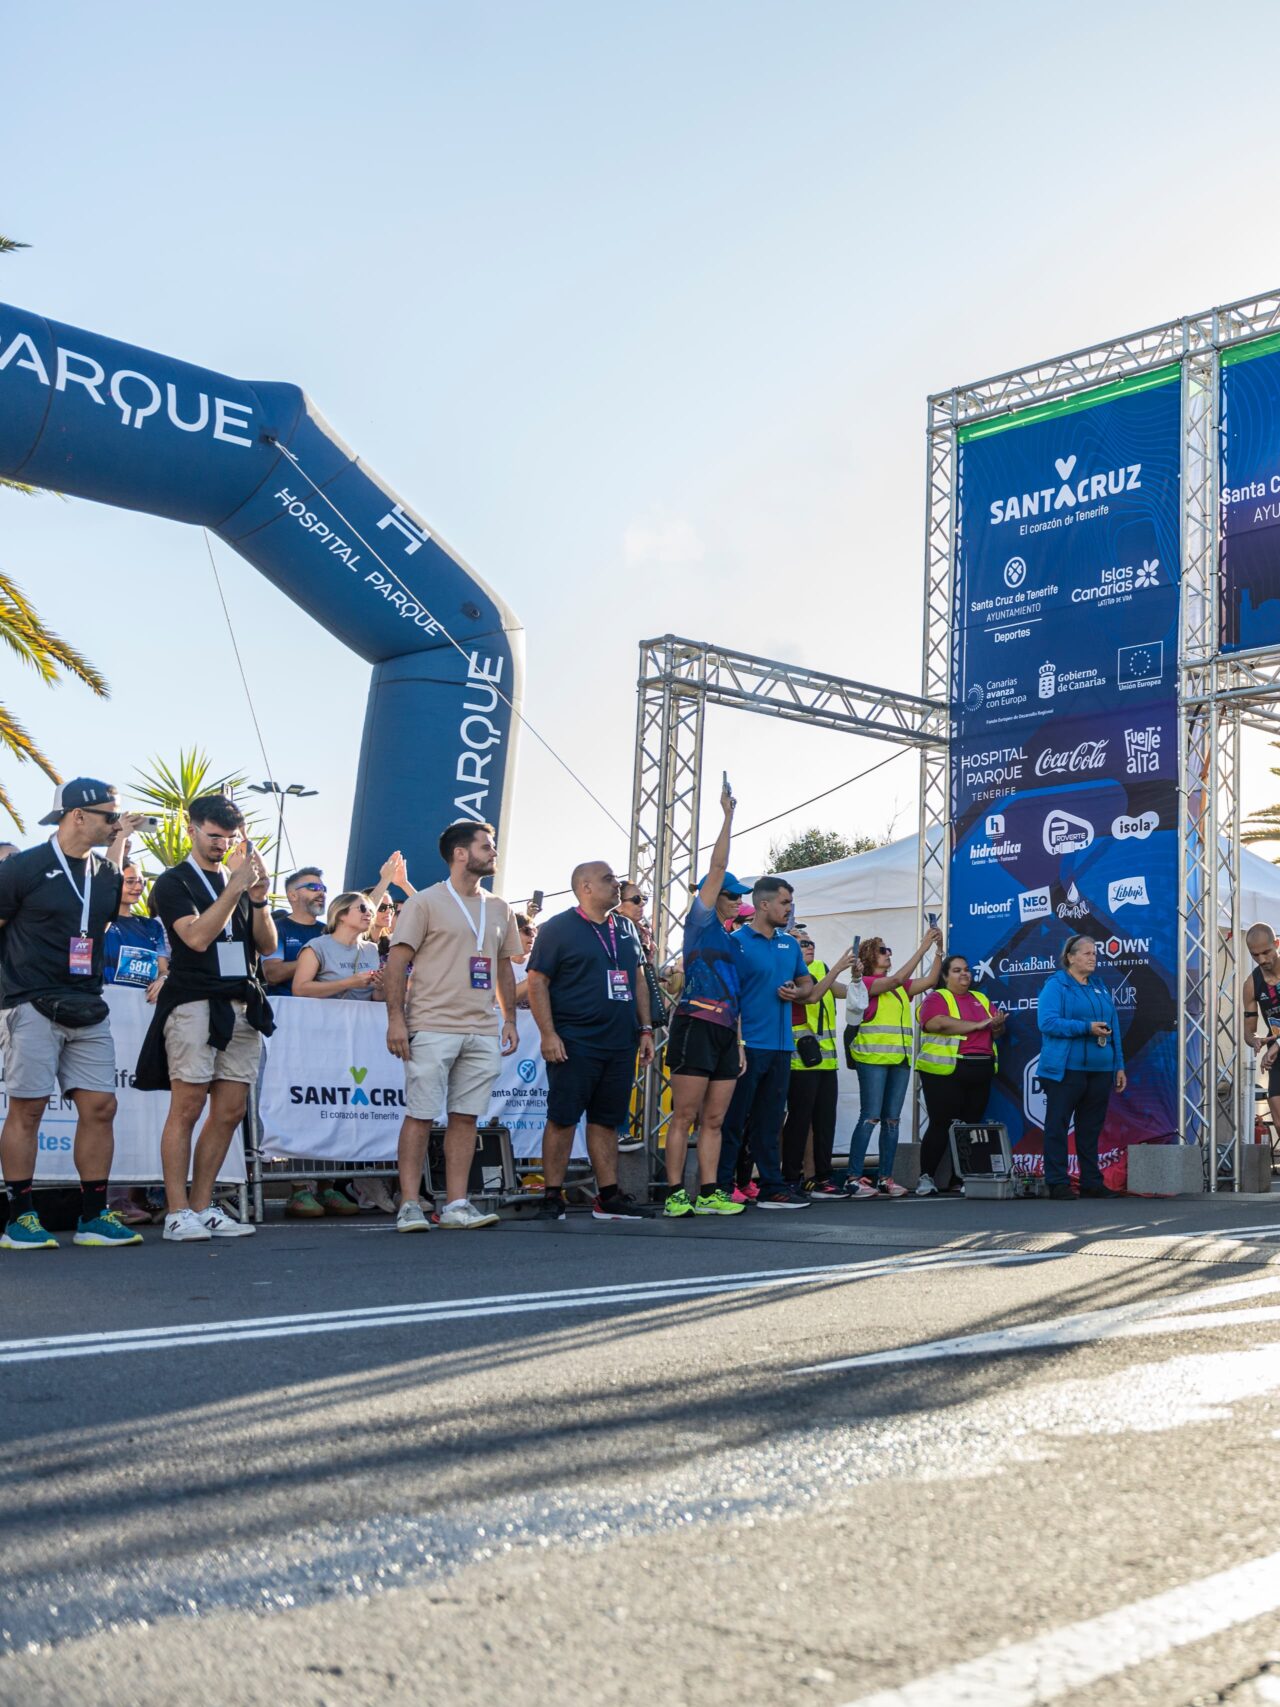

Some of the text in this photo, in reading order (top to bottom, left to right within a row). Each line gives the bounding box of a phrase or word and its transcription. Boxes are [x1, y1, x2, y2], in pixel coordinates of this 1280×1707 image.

[0, 332, 253, 447] ARQUE
[1221, 482, 1265, 505] Santa
[1020, 505, 1109, 536] El corazón de Tenerife
[274, 488, 440, 637] HOSPITAL PARQUE
[1101, 566, 1133, 583] Islas
[971, 584, 1058, 612] Santa Cruz de Tenerife
[1071, 579, 1133, 603] Canarias
[986, 602, 1041, 623] AYUNTAMIENTO
[994, 627, 1030, 643] Deportes
[986, 677, 1018, 690] Canarias
[1057, 668, 1097, 683] Gobierno
[1057, 677, 1106, 693] de Canarias
[1119, 679, 1161, 691] Unión Europea
[986, 688, 1014, 699] avanza
[986, 694, 1027, 708] con Europa
[450, 651, 504, 824] ARQUE
[961, 746, 1028, 769] HOSPITAL
[966, 765, 1022, 786] PARQUE
[971, 786, 1016, 801] TENERIFE
[1120, 820, 1150, 834] isola
[970, 841, 1022, 859] hidráulica
[1023, 895, 1047, 907] NEO
[1113, 885, 1144, 901] Libby's
[970, 899, 1012, 915] Uniconf
[1000, 955, 1055, 973] CaixaBank
[1108, 959, 1149, 967] NUTRITION
[321, 1111, 328, 1119] El
[330, 1111, 358, 1119] corazón
[371, 1112, 399, 1120] Tenerife
